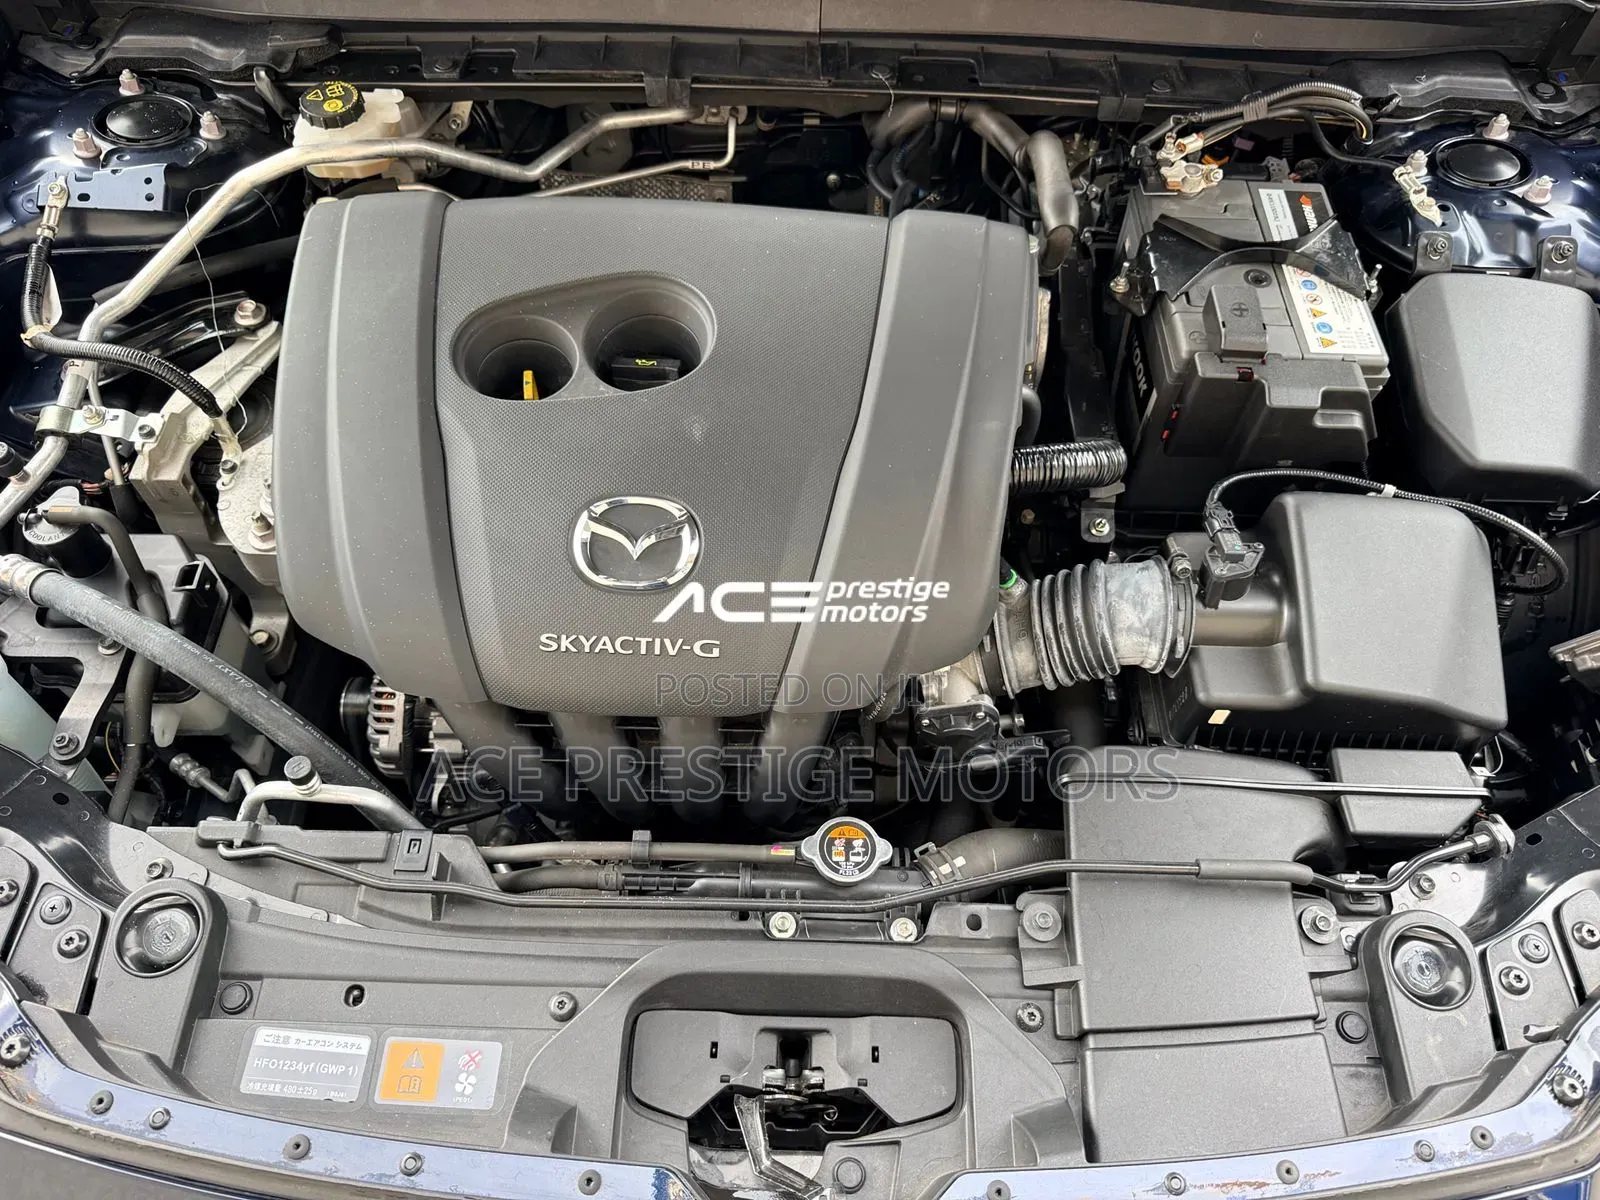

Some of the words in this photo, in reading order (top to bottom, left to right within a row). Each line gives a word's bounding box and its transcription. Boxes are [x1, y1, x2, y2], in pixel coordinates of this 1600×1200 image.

[539, 633, 721, 658] SKYACTIV-G
[254, 1057, 316, 1075] HFO1234yf
[316, 1061, 346, 1076] (GWP
[348, 1064, 359, 1078] 1)
